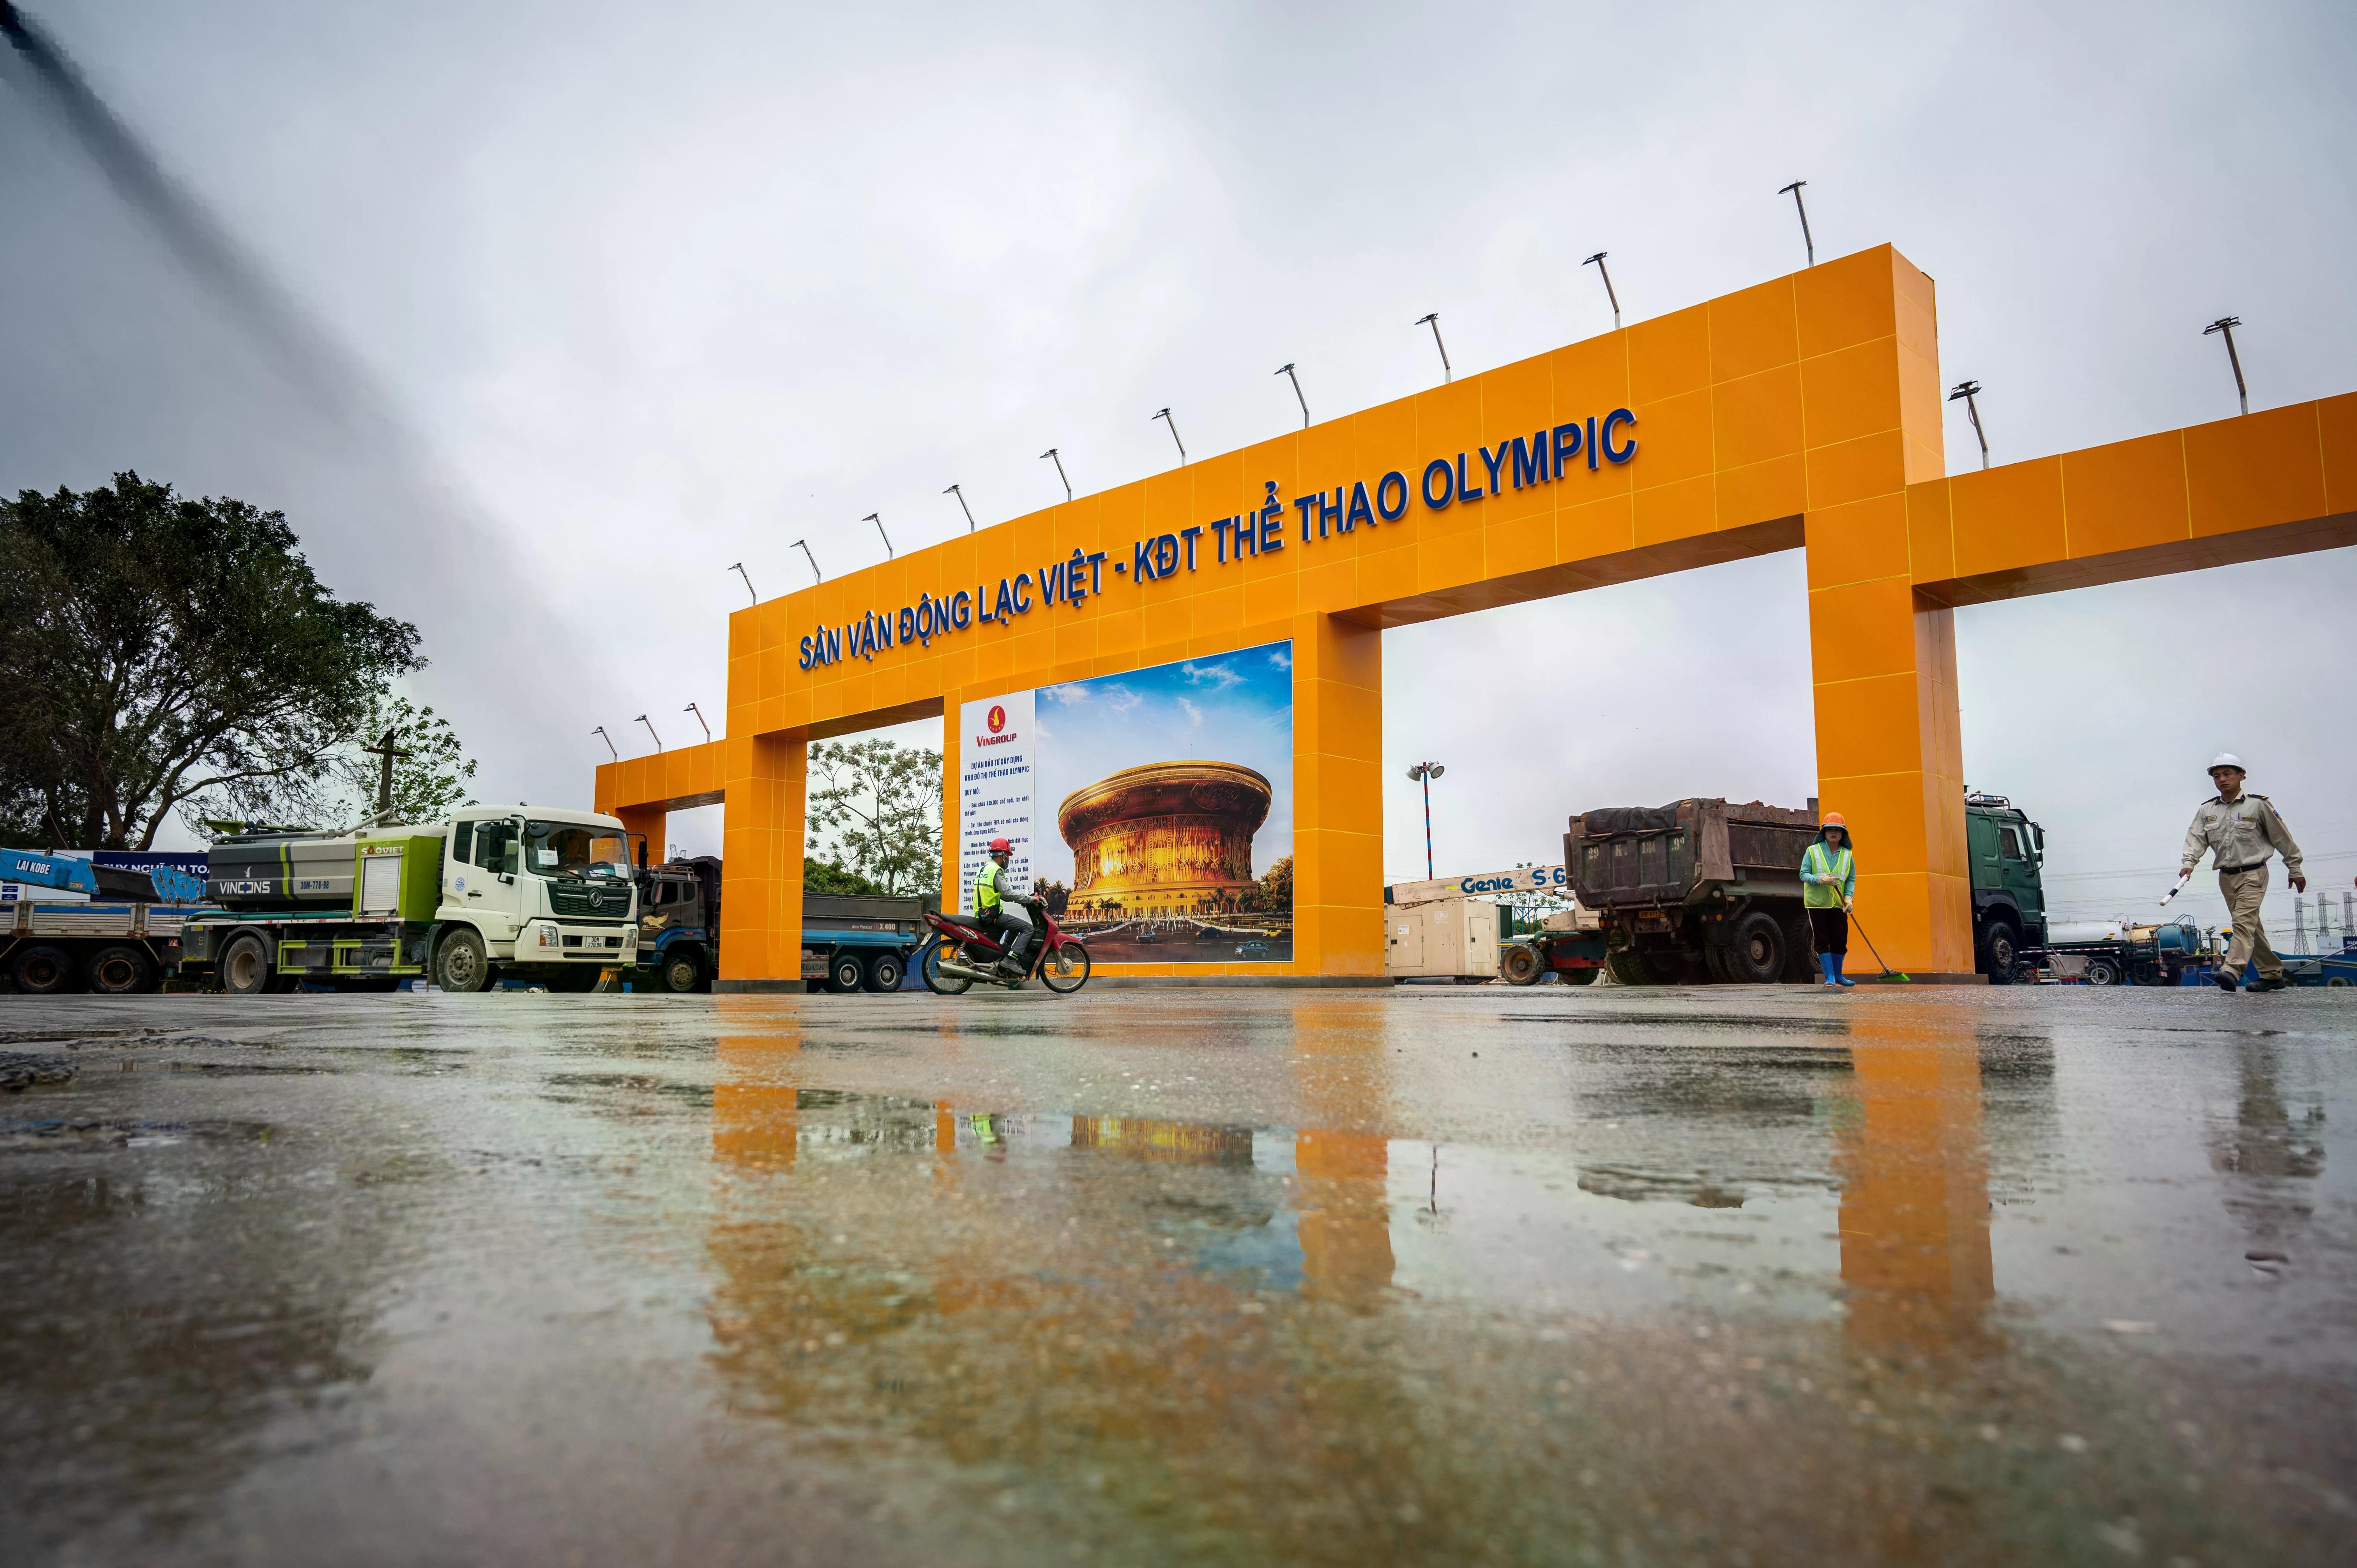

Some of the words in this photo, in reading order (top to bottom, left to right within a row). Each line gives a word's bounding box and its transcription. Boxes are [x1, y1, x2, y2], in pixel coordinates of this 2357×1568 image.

[799, 625, 842, 670] SÂN
[847, 610, 894, 660] VẬN
[898, 592, 972, 647] ĐỘNG
[978, 573, 1033, 625] LẠC
[1039, 548, 1108, 608] VIỆT
[1134, 525, 1203, 583] KĐT
[1211, 480, 1284, 563] THỂ
[1294, 471, 1410, 542] THAO
[1422, 408, 1638, 510] OLYMPIC
[976, 733, 1017, 747] VINGROUP
[997, 768, 1008, 777] THAO
[1010, 766, 1029, 775] OLYMPIC
[16, 860, 28, 871] LAI
[30, 862, 51, 875] KOBE
[190, 865, 210, 874] TO
[220, 881, 270, 894] VINCONS
[1461, 876, 1514, 894] Genie
